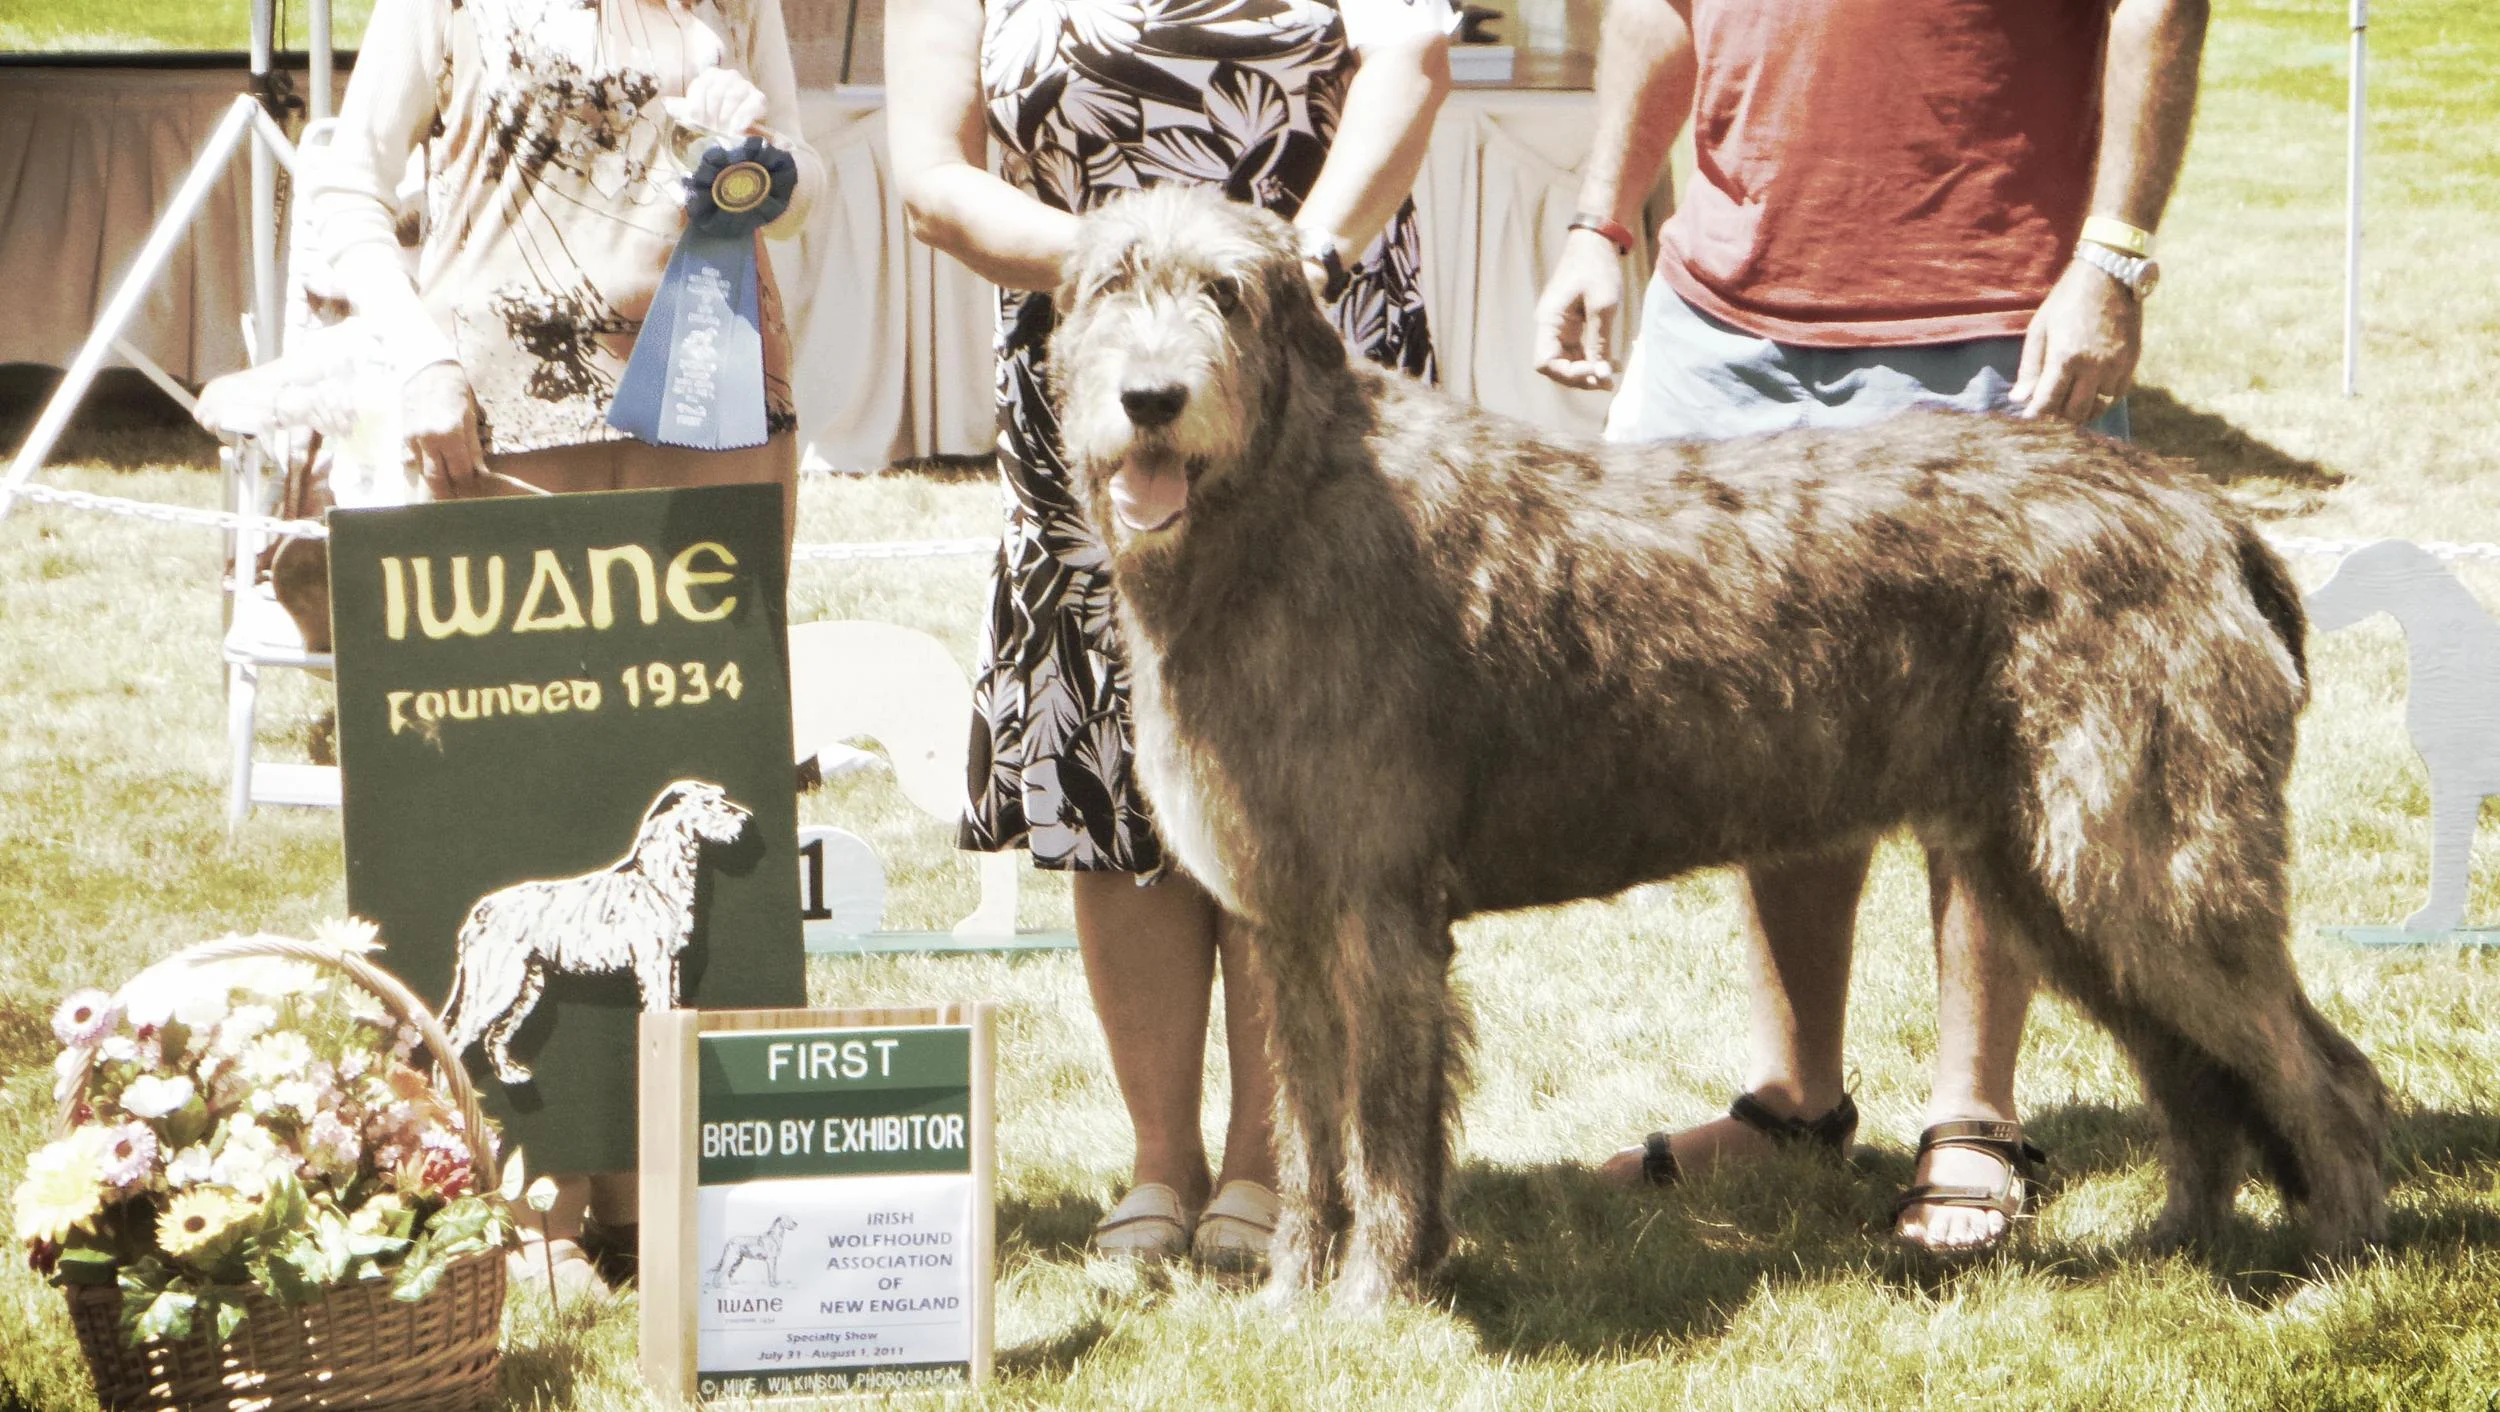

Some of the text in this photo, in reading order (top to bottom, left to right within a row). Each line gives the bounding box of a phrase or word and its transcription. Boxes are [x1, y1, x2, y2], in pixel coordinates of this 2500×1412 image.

[621, 660, 743, 709] 1934
[767, 1040, 899, 1081] FIRST
[703, 1114, 965, 1158] BRED BY EXHIBITOR
[866, 1212, 915, 1226] IRISH
[828, 1232, 953, 1249] WOLFHOUND
[827, 1253, 953, 1271] ASSOCIATION
[878, 1277, 903, 1291] OF
[820, 1297, 960, 1315] NEW ENGLAND
[786, 1331, 879, 1344] Specialty Show
[758, 1350, 783, 1361] July
[787, 1351, 801, 1360] 31
[812, 1348, 856, 1361] August
[873, 1347, 905, 1358] 2011
